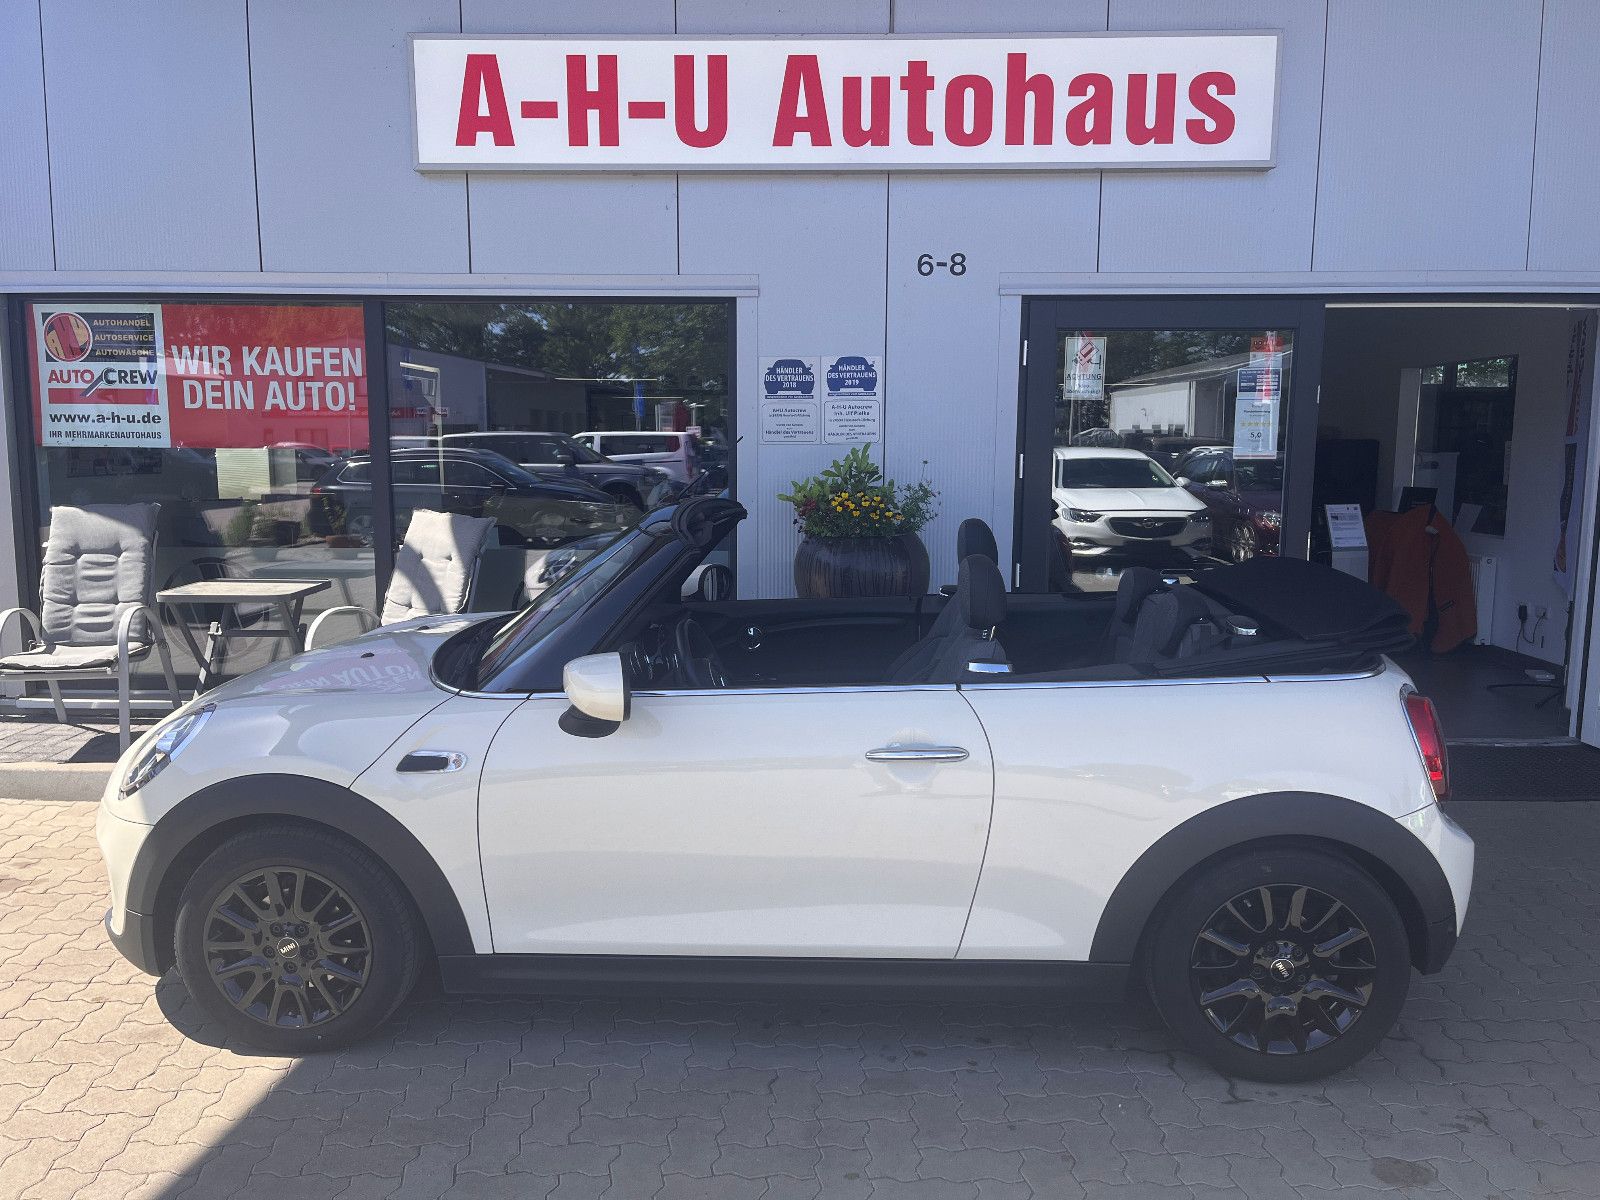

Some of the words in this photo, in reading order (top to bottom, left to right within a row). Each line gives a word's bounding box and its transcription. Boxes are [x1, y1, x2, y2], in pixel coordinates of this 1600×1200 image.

[456, 54, 729, 147] A-H-U
[774, 53, 1236, 147] Autohaus
[917, 252, 967, 276] 6-8
[93, 319, 151, 327] AUTOHANDEL
[171, 345, 233, 376] WIR
[242, 346, 363, 377] KAUFEN
[47, 369, 95, 384] AUTO
[103, 367, 158, 385] CREW
[766, 374, 776, 382] DES
[777, 374, 814, 382] VERTRAUENS
[839, 371, 876, 379] VERTRAUENS
[1066, 372, 1102, 380] ACHTUNG
[182, 380, 255, 410] DEIN
[264, 381, 357, 411] AUTO!
[49, 412, 162, 424] www.a-h-u.de
[49, 430, 62, 438] IHR
[65, 430, 162, 439] MEHRMARKENAUTOHAUS
[280, 942, 295, 954] MINI
[1275, 962, 1289, 977] MINI
